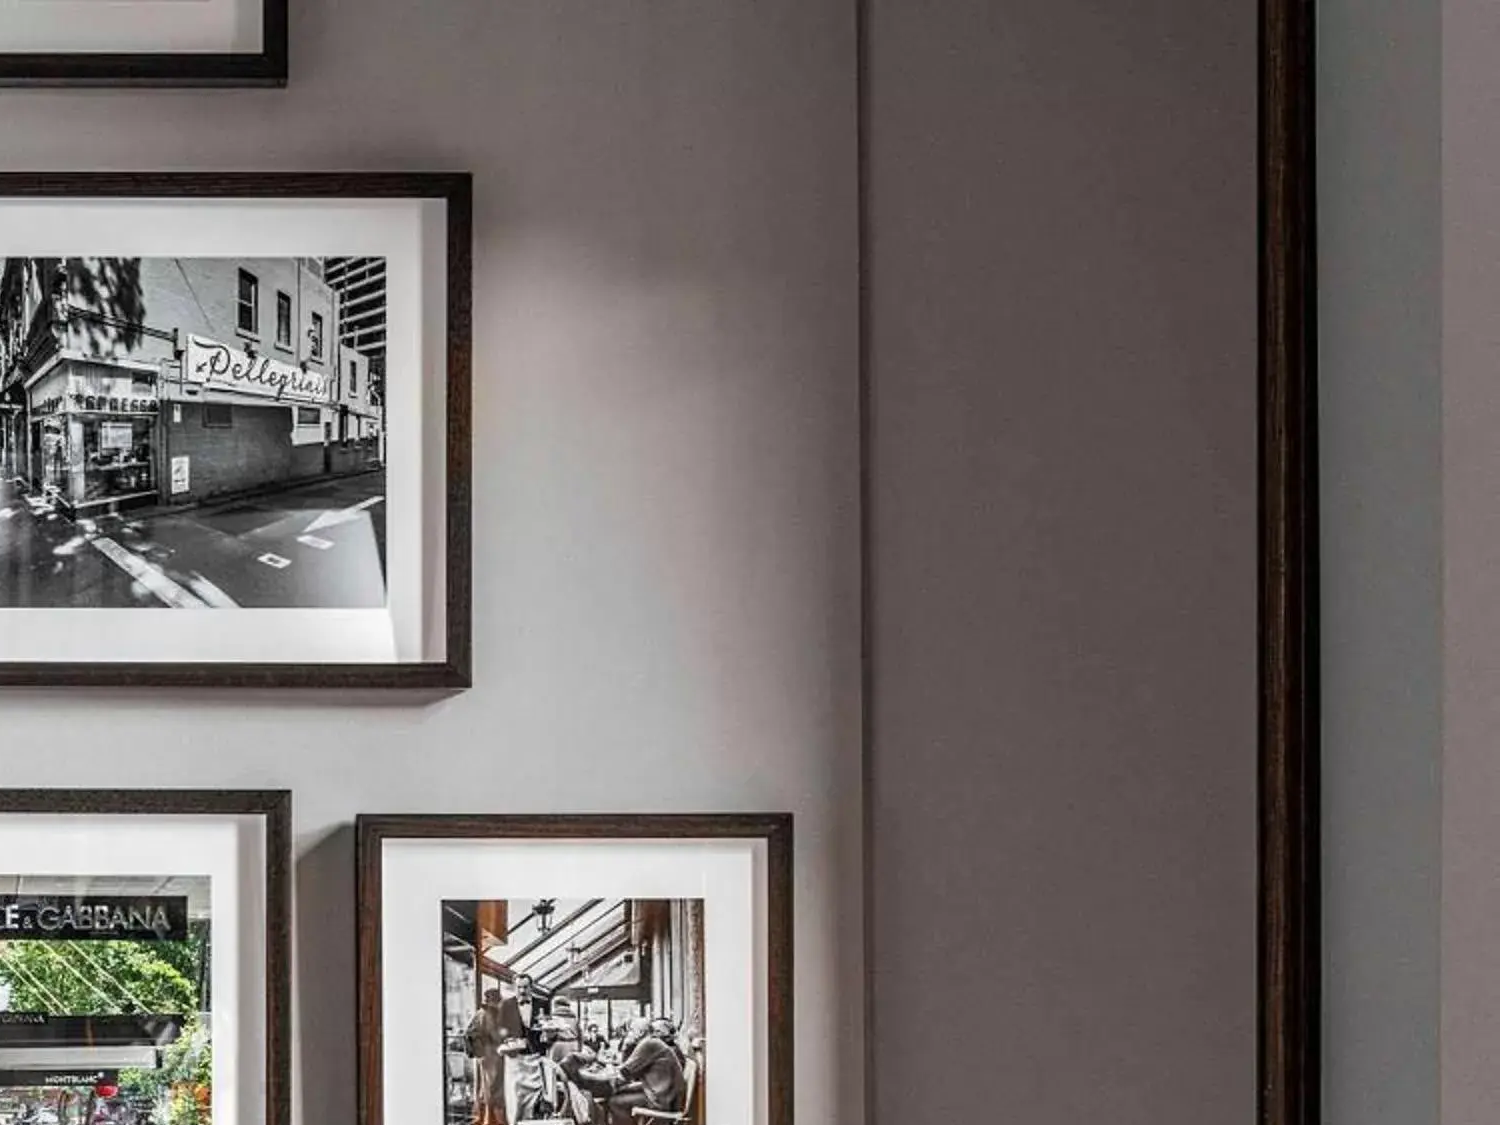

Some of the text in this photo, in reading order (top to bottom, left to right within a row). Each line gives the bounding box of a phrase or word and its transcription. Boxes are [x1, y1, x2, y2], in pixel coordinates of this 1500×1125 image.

[22, 917, 33, 929] &
[36, 904, 171, 930] GABBANA
[45, 1075, 98, 1084] MONTBLANC
